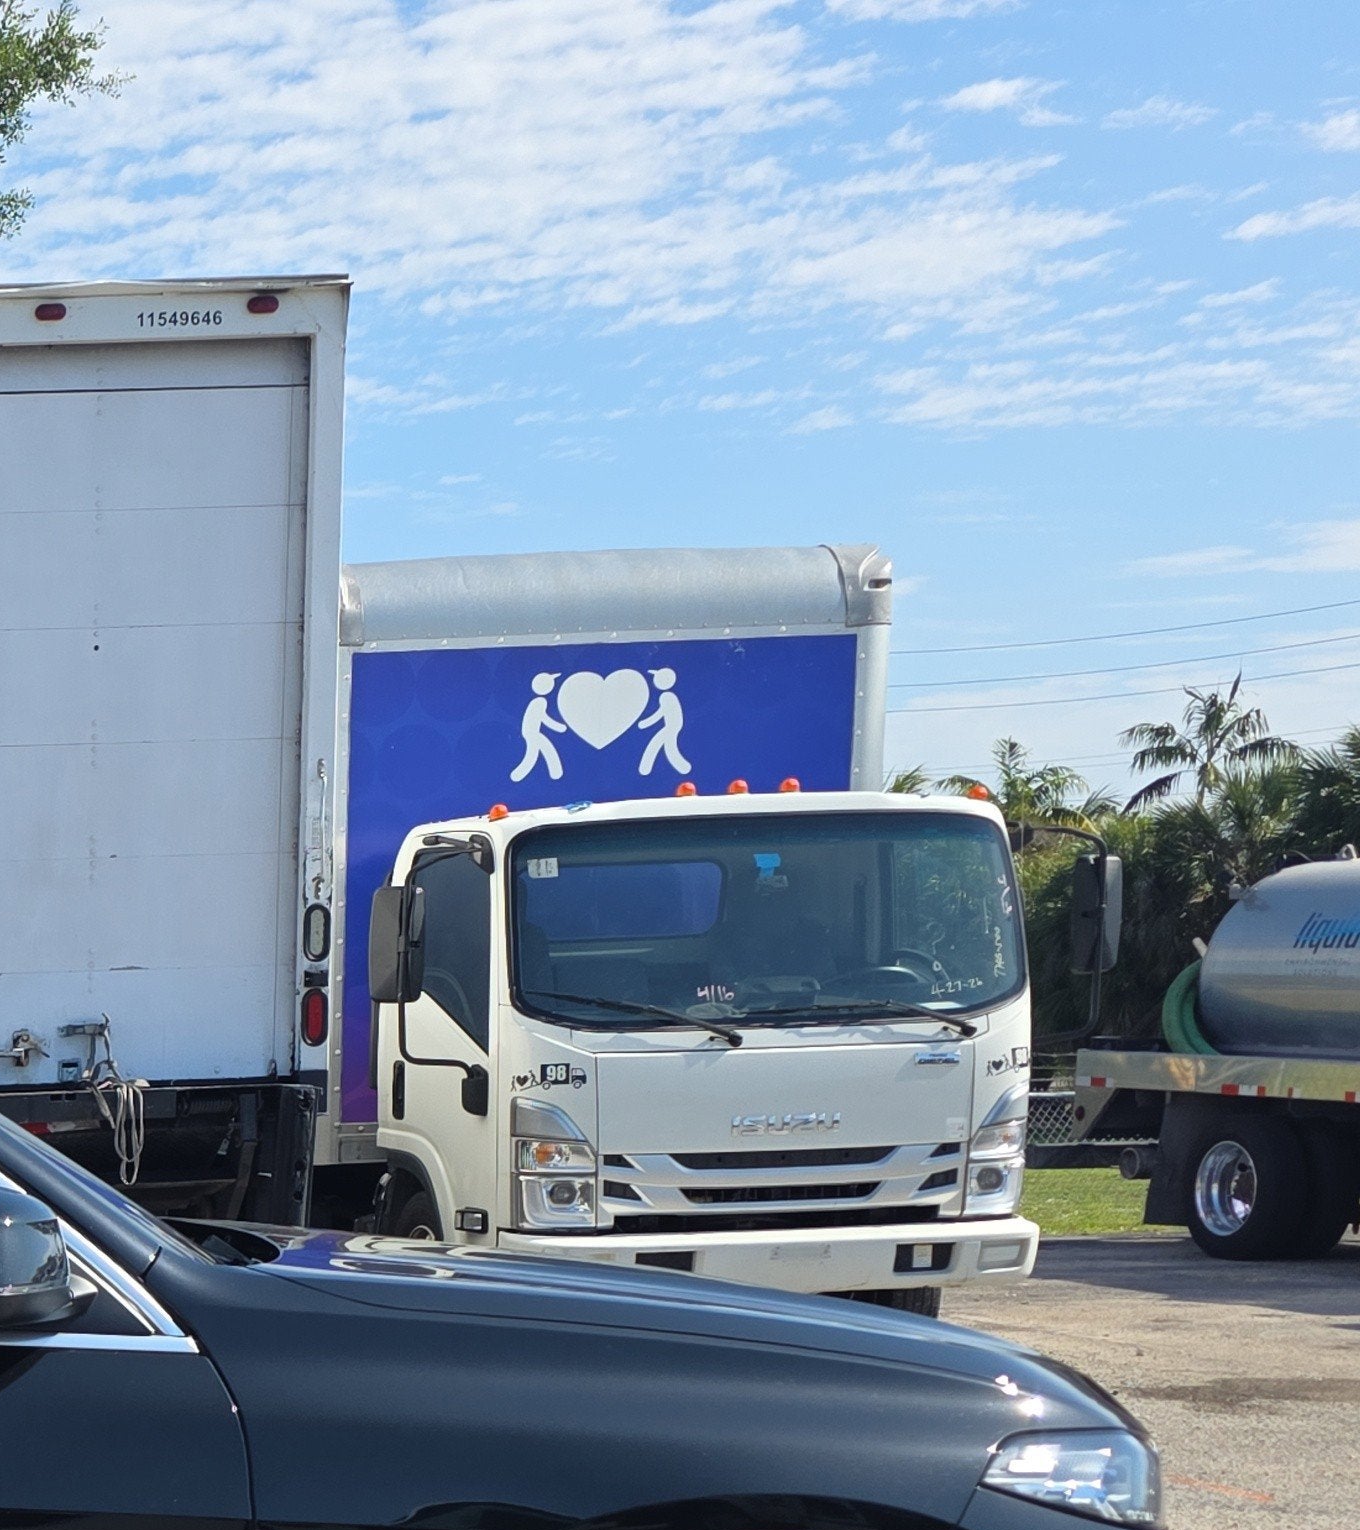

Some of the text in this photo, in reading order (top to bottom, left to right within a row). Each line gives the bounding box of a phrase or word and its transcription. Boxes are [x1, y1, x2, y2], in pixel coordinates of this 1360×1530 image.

[136, 310, 223, 328] 11549646
[546, 1065, 567, 1081] 98
[730, 1112, 841, 1138] ISUZU
